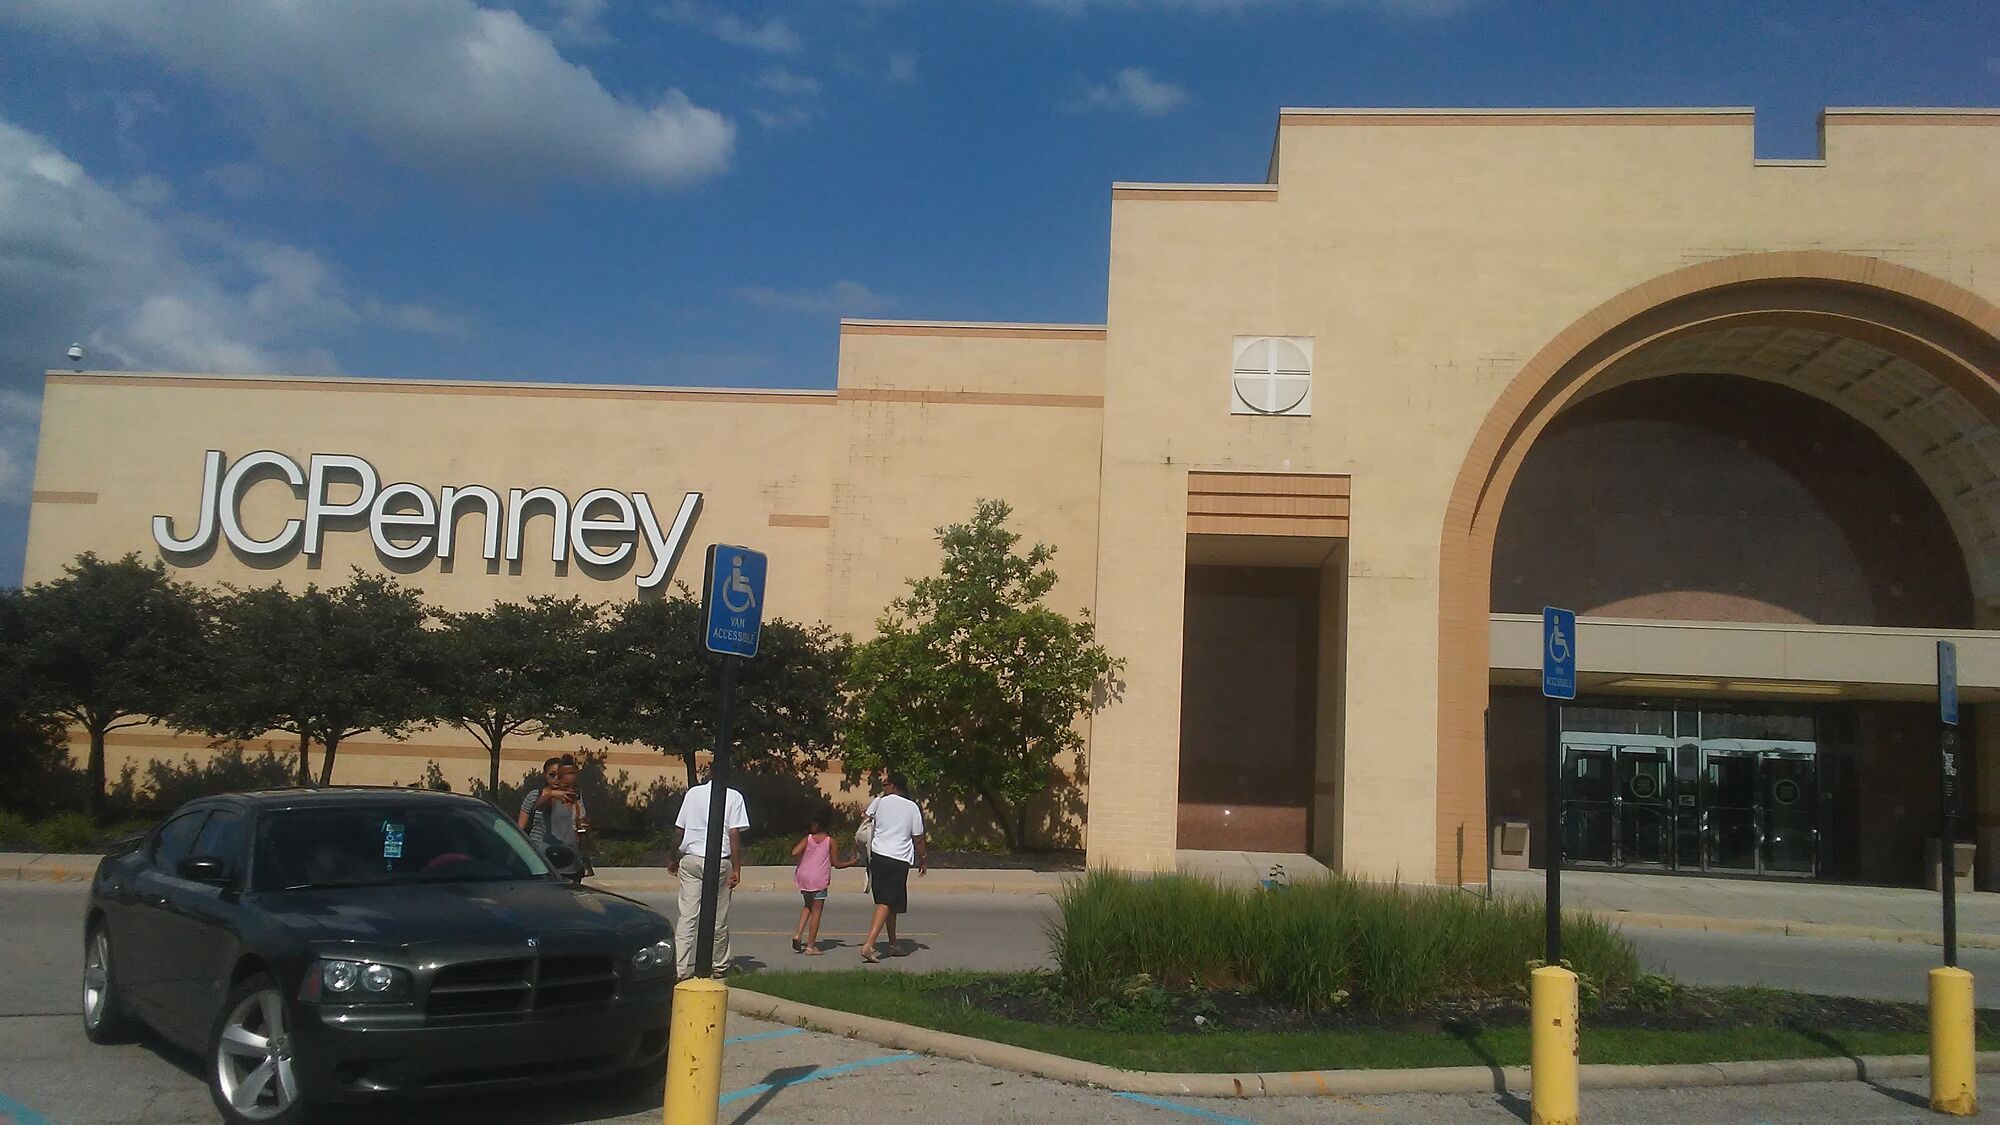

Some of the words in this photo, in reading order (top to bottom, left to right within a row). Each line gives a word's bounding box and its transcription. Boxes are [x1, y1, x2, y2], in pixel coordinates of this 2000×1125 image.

[152, 449, 703, 588] JCPenney
[731, 617, 745, 628] VAN
[713, 628, 757, 645] ACCESSIBLE
